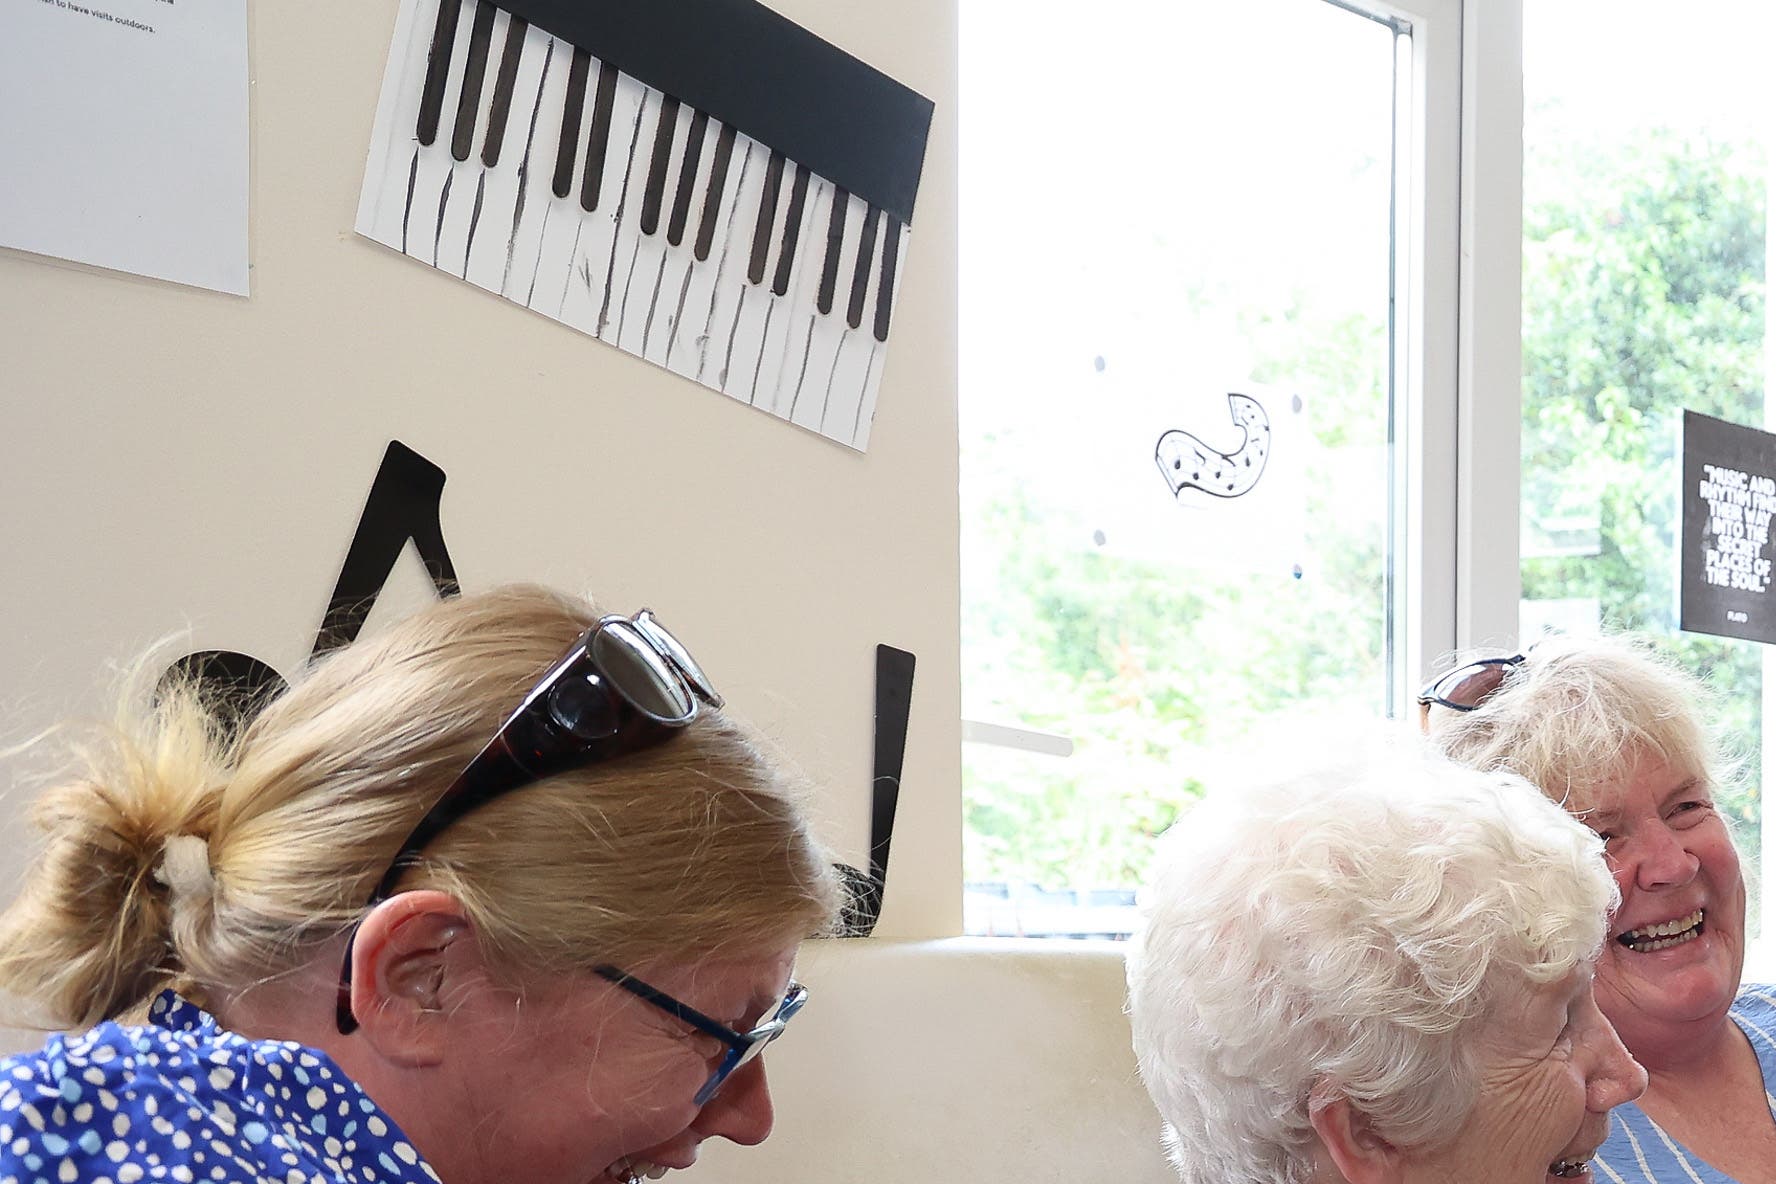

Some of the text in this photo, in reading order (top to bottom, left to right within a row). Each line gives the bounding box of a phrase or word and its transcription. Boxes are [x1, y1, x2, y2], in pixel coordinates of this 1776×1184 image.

[56, 0, 156, 33] to have visits outdoors.
[1699, 479, 1751, 508] RHYTHM
[1749, 475, 1776, 496] AND
[1711, 516, 1769, 545] INTO THE
[1744, 507, 1773, 527] WAY
[1717, 534, 1763, 560] SECRET
[1706, 548, 1771, 577] PLACES OF
[1705, 566, 1730, 587] THE
